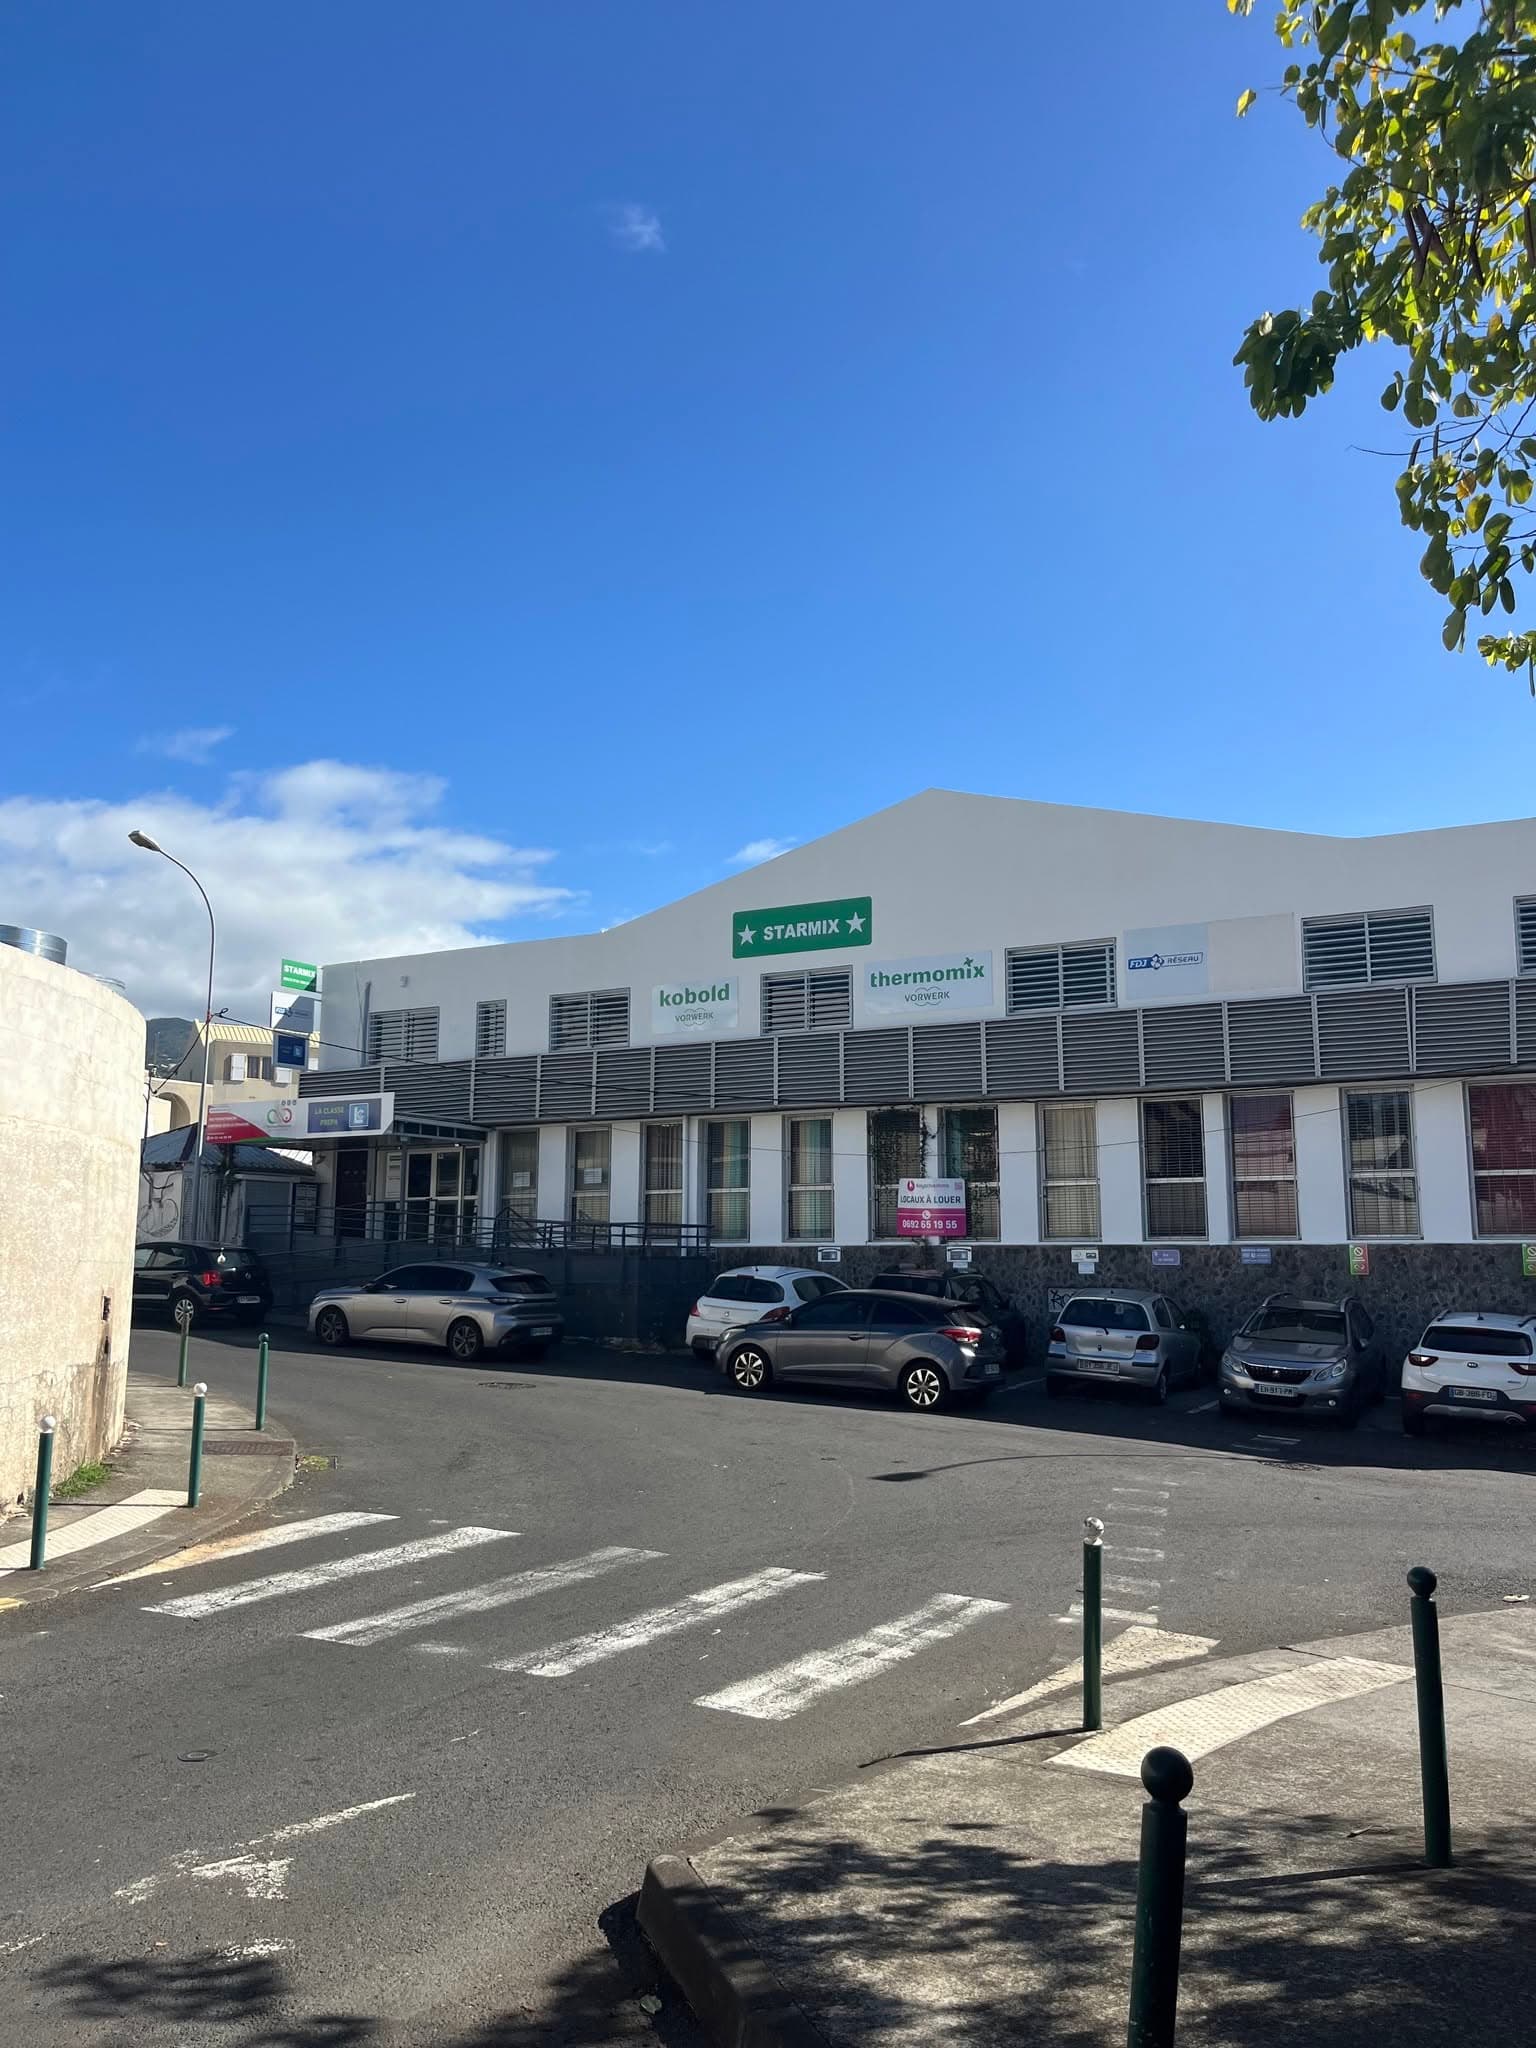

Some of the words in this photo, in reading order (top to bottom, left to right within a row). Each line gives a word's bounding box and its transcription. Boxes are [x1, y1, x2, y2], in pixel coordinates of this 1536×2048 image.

[763, 918, 840, 941] STARMIX
[1129, 959, 1148, 968] FDJ
[284, 965, 316, 978] STARMIX
[870, 957, 985, 988] thermomix
[660, 983, 729, 1007] kobold
[904, 991, 950, 1003] VORWERK
[675, 1011, 714, 1022] VORWERK
[900, 1195, 925, 1204] LOCAUX
[934, 1195, 961, 1204] LOUER
[902, 1219, 919, 1229] 0692
[920, 1220, 932, 1229] 65
[933, 1220, 943, 1229] 19
[945, 1220, 957, 1229] 55
